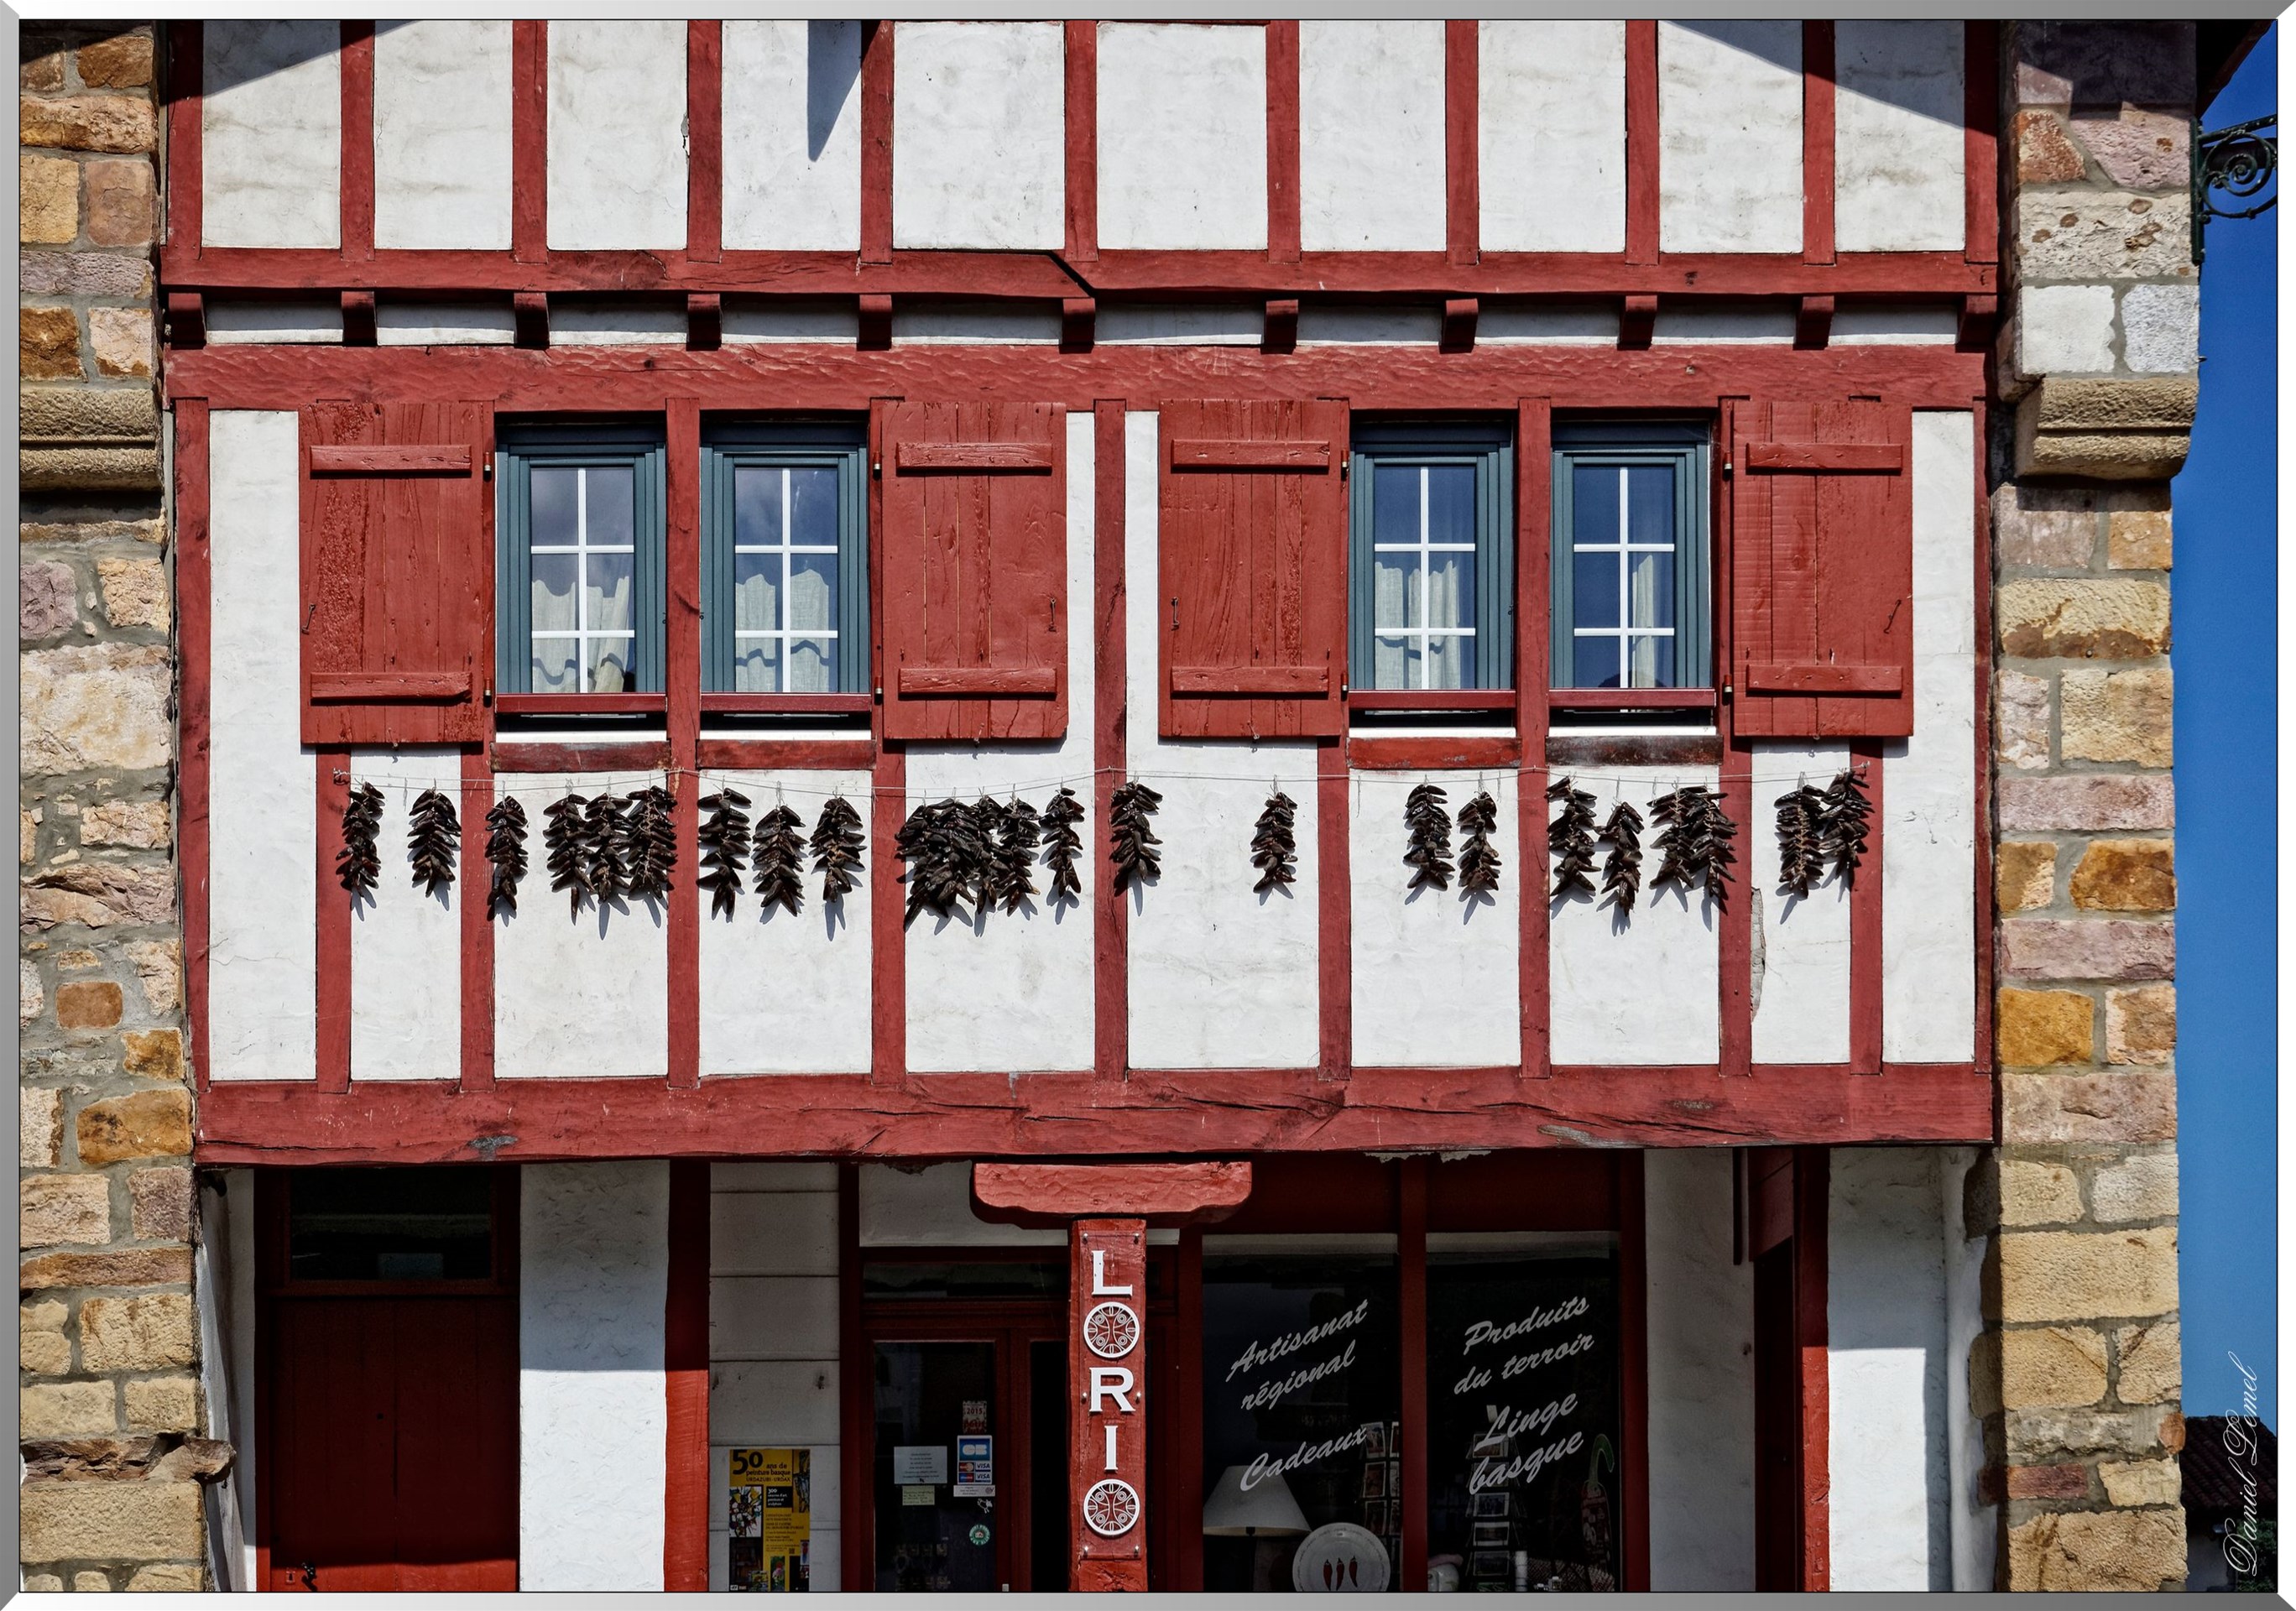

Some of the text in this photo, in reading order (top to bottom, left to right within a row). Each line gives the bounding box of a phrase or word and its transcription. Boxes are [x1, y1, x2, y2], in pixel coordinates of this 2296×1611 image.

[1225, 1299, 1369, 1383] Artisanat
[1463, 1296, 1589, 1356] Produits
[1083, 1250, 1140, 1536] LORIO
[1240, 1339, 1356, 1410] régional
[1453, 1333, 1595, 1395] du terroir
[1474, 1393, 1578, 1452] Linge
[733, 1449, 764, 1475] 50
[770, 1468, 791, 1477] basque
[1239, 1427, 1367, 1491] Cadeaux
[1469, 1431, 1584, 1495] basque
